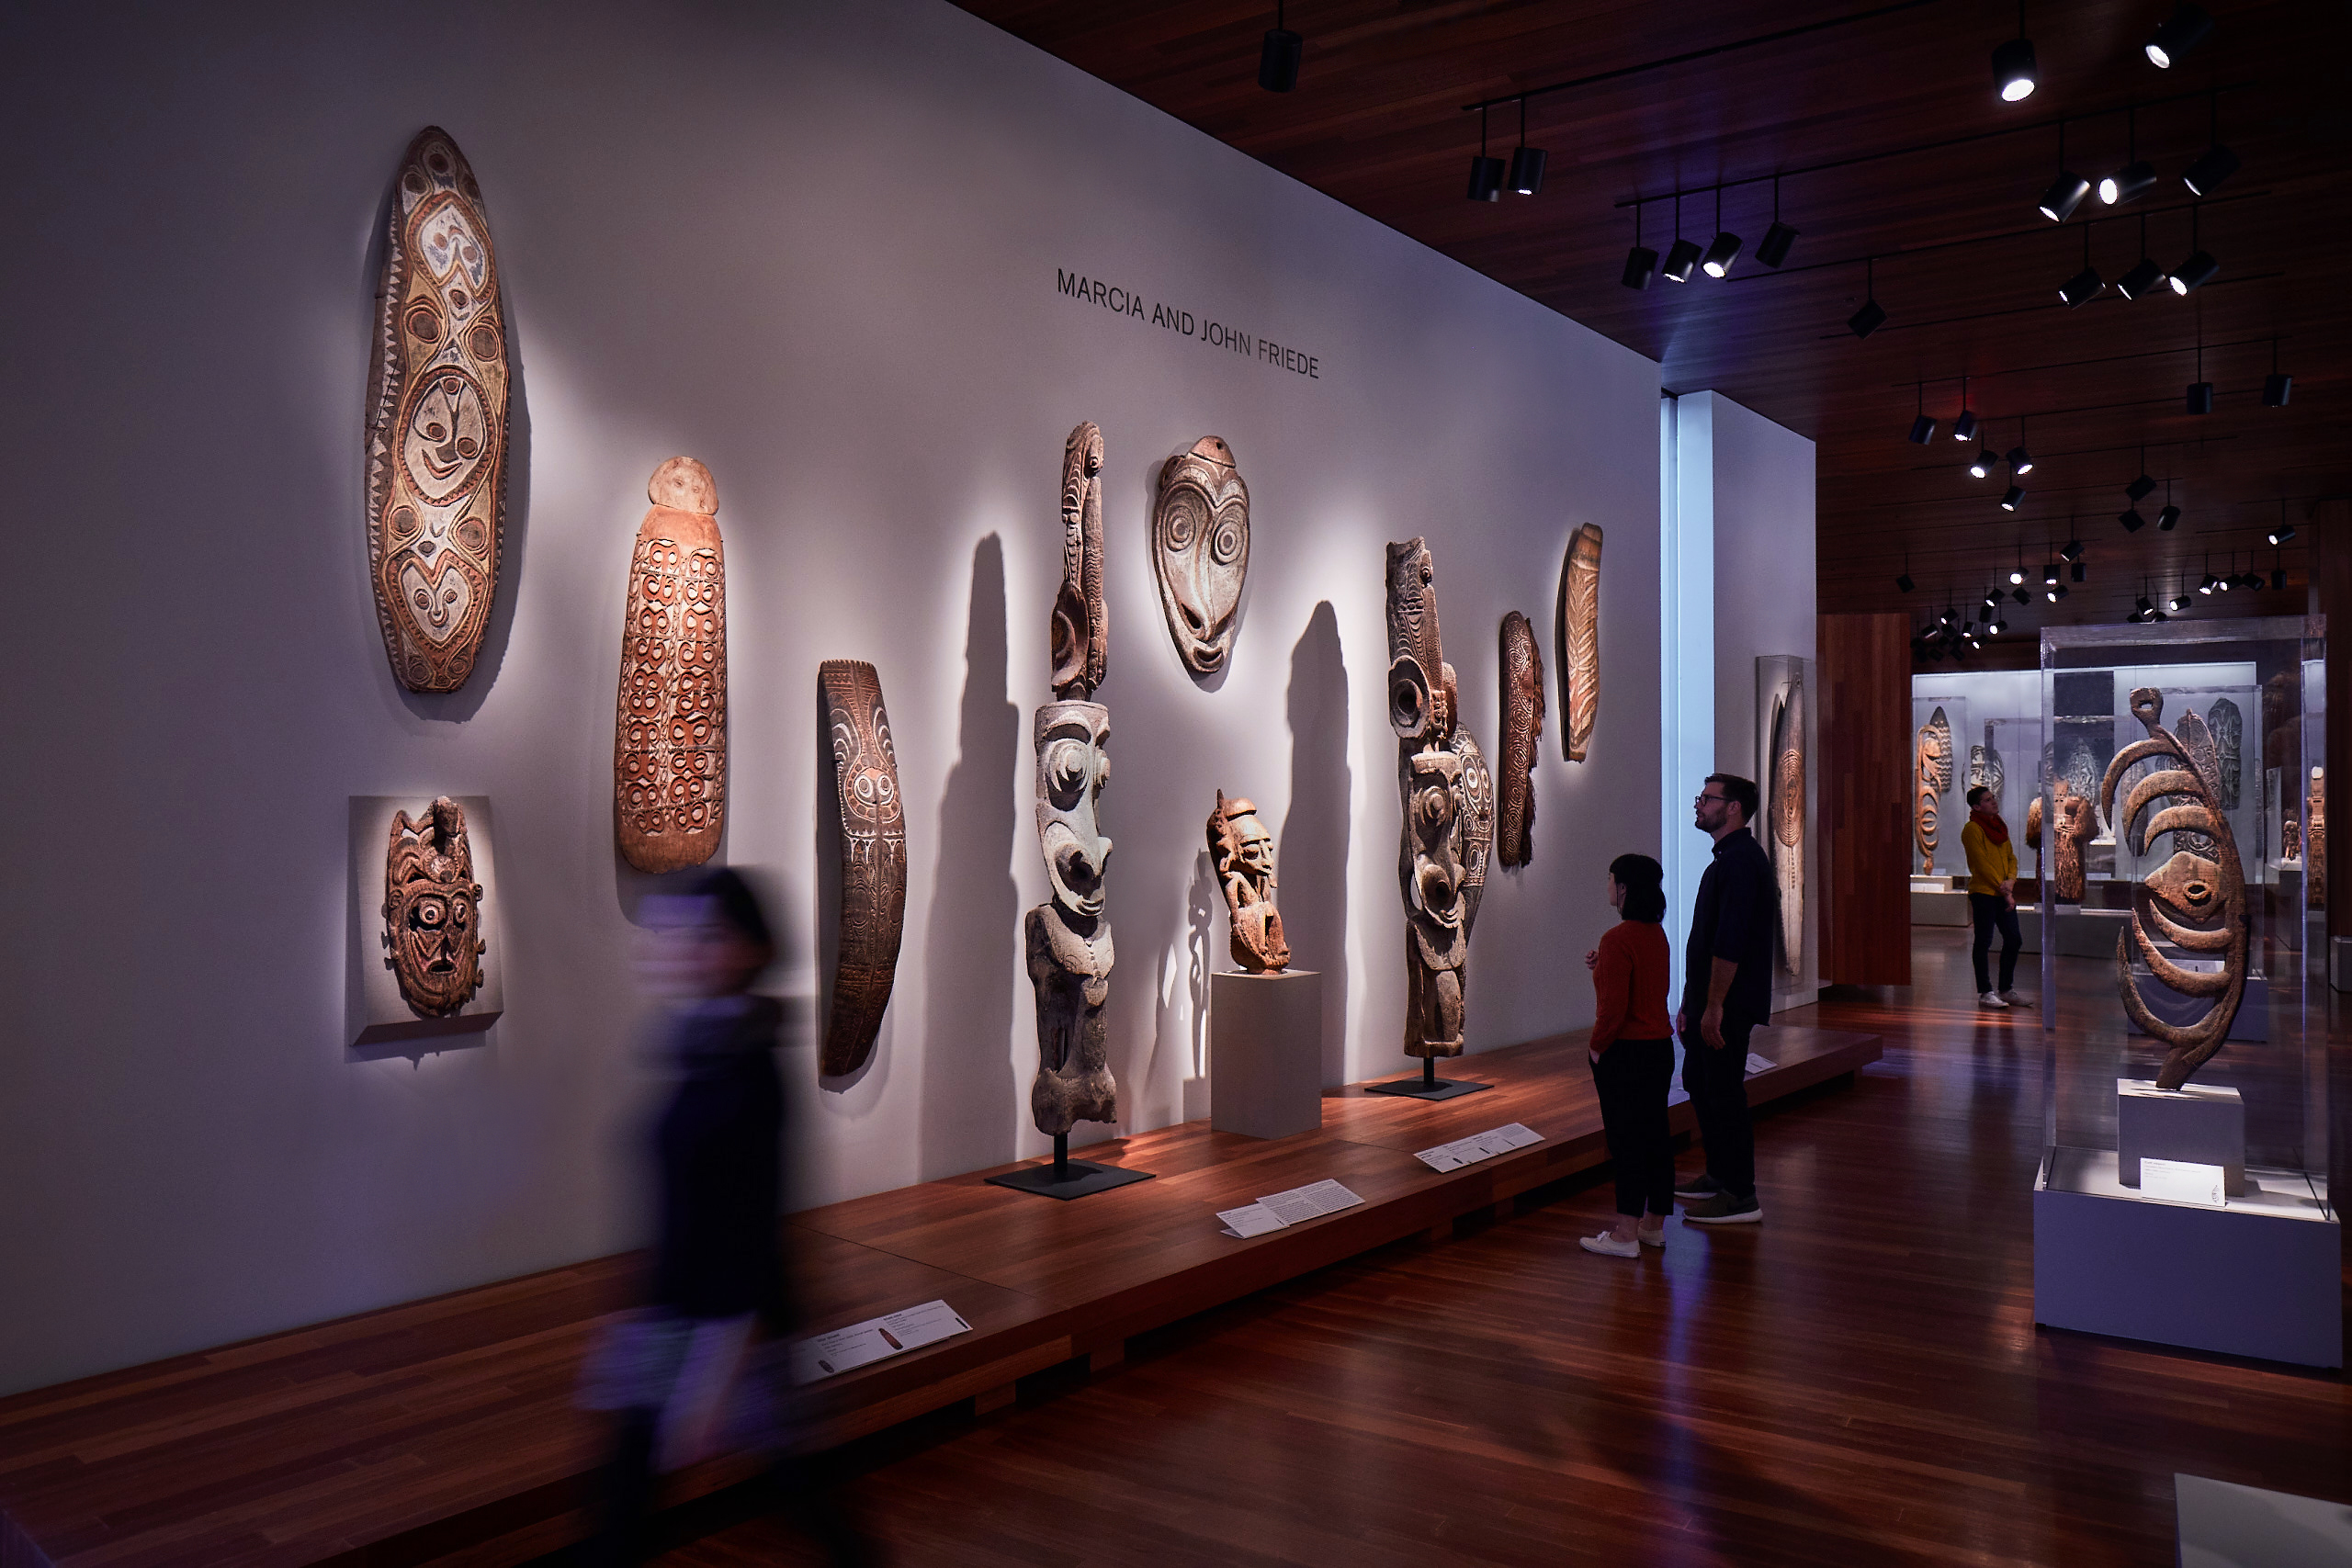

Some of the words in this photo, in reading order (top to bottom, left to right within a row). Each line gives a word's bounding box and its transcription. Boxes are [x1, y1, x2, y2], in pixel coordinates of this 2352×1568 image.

[1057, 268, 1145, 321] MARCIA
[1151, 302, 1194, 336] AND
[1200, 319, 1250, 356] JOHN
[1258, 338, 1319, 379] FRIEDE
